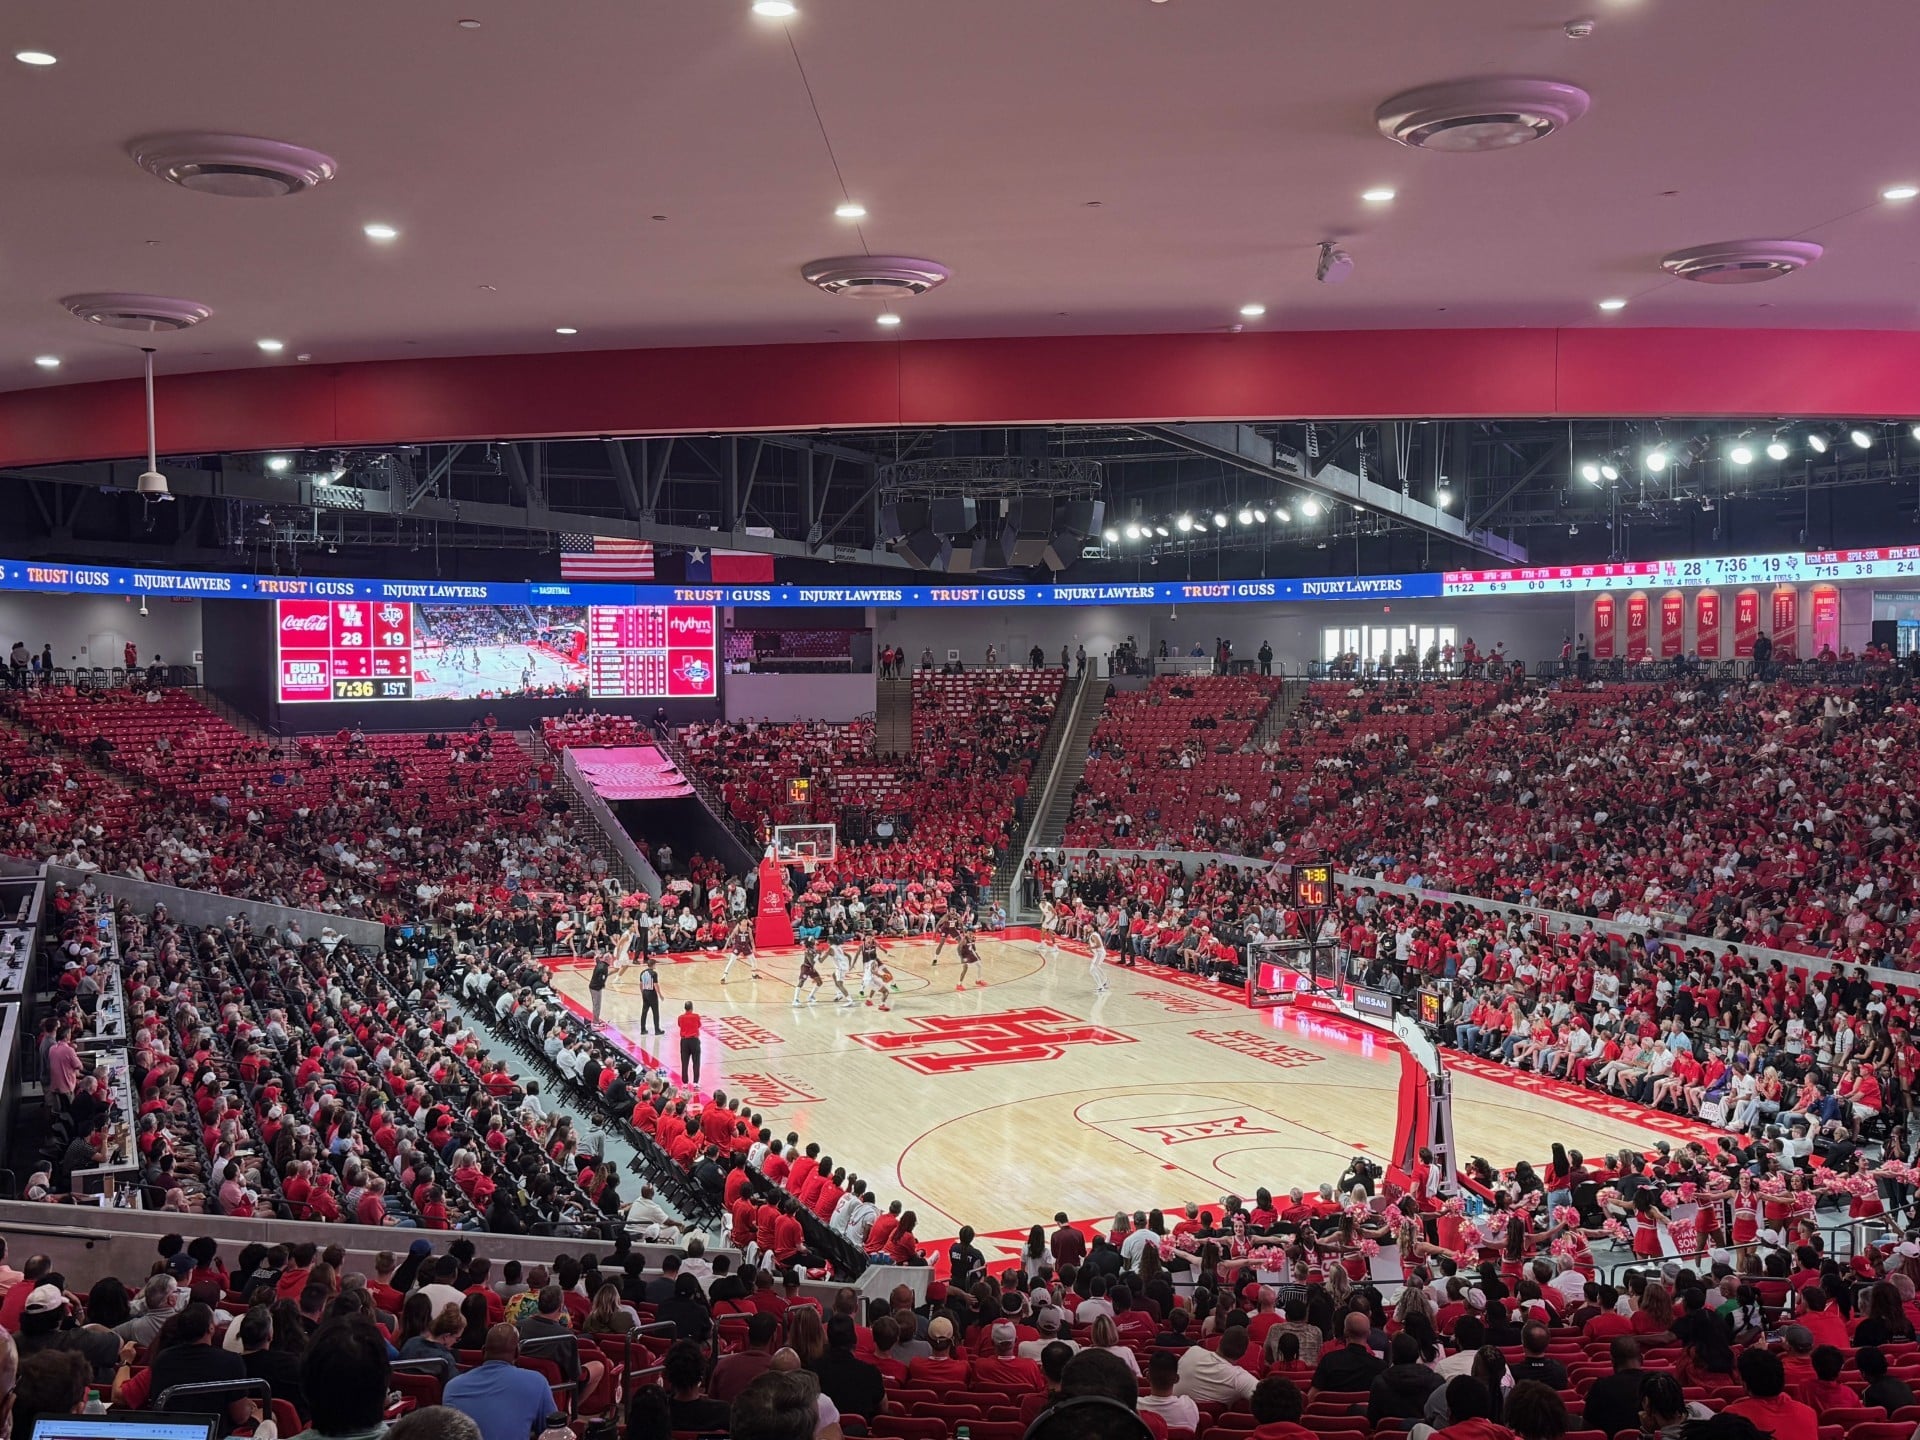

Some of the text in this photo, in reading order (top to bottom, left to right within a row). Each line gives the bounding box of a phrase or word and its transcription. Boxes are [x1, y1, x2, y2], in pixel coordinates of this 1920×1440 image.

[1684, 562, 1702, 576] 28
[1715, 558, 1747, 572] 7:36
[1762, 558, 1780, 572] 19
[27, 567, 110, 586] TRUST GUSS
[134, 574, 231, 591] INJURY LAWYERS
[1585, 579, 1591, 587] 7
[1606, 578, 1612, 586] 2
[1627, 577, 1633, 586] 3
[1650, 575, 1656, 584] 2
[1724, 575, 1737, 583] 1ST
[259, 579, 354, 595] TRUST GUSS
[1182, 584, 1275, 597] TRUST GUSS
[1302, 579, 1402, 596] INJURY LAWYERS
[1560, 580, 1572, 588] 13
[383, 584, 487, 598] INJURY LAWYERS
[674, 589, 771, 601] TRUST GUSS
[800, 590, 902, 603] INJURY LAWYERS
[930, 589, 1026, 601] TRUST GUSS
[1054, 587, 1155, 600] INJURY LAWYERS
[1600, 614, 1608, 627] 10
[1632, 613, 1641, 626] 22
[1667, 612, 1676, 625] 34
[1702, 611, 1713, 625] 42
[1741, 609, 1751, 623] 44
[670, 616, 711, 633] rhythm
[341, 632, 363, 645] 28
[383, 632, 404, 645] 19
[290, 663, 319, 674] BUD
[285, 674, 325, 685] LIGHT
[336, 681, 374, 696] 7:36
[383, 682, 405, 695] 1ST
[1303, 868, 1326, 882] 7:36
[1357, 995, 1387, 1009] NISSAN
[720, 1016, 785, 1044] CENTER
[1187, 1030, 1308, 1068] FERTITTA
[1223, 1030, 1327, 1062] CENTER
[778, 1073, 815, 1091] COURT
[1540, 1083, 1722, 1139] HOWIE
[1678, 1238, 1697, 1249] SOM
